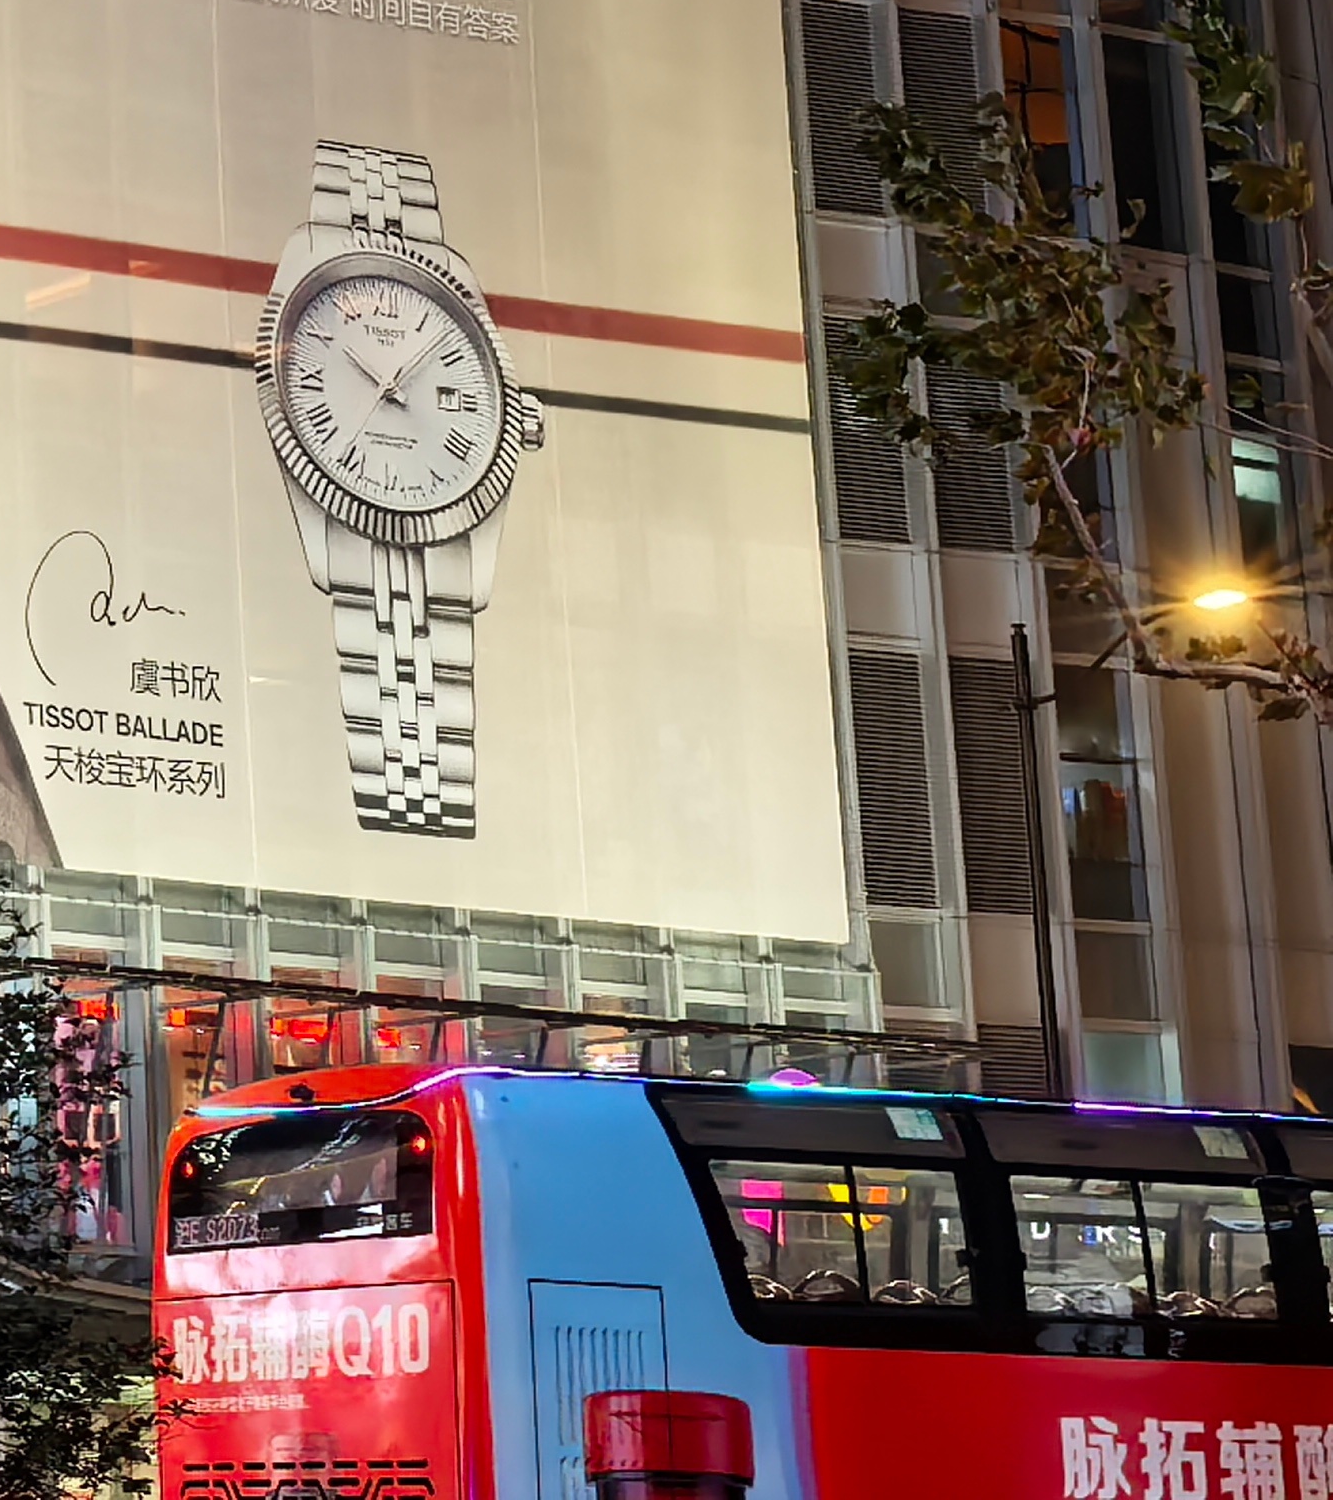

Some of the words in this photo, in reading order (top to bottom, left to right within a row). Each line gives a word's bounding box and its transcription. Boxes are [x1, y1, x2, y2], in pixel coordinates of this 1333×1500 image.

[130, 658, 222, 703] 虞书欣
[23, 701, 109, 734] TISSOT
[116, 713, 224, 747] BALLADE
[44, 745, 226, 798] 天梭宝环系列
